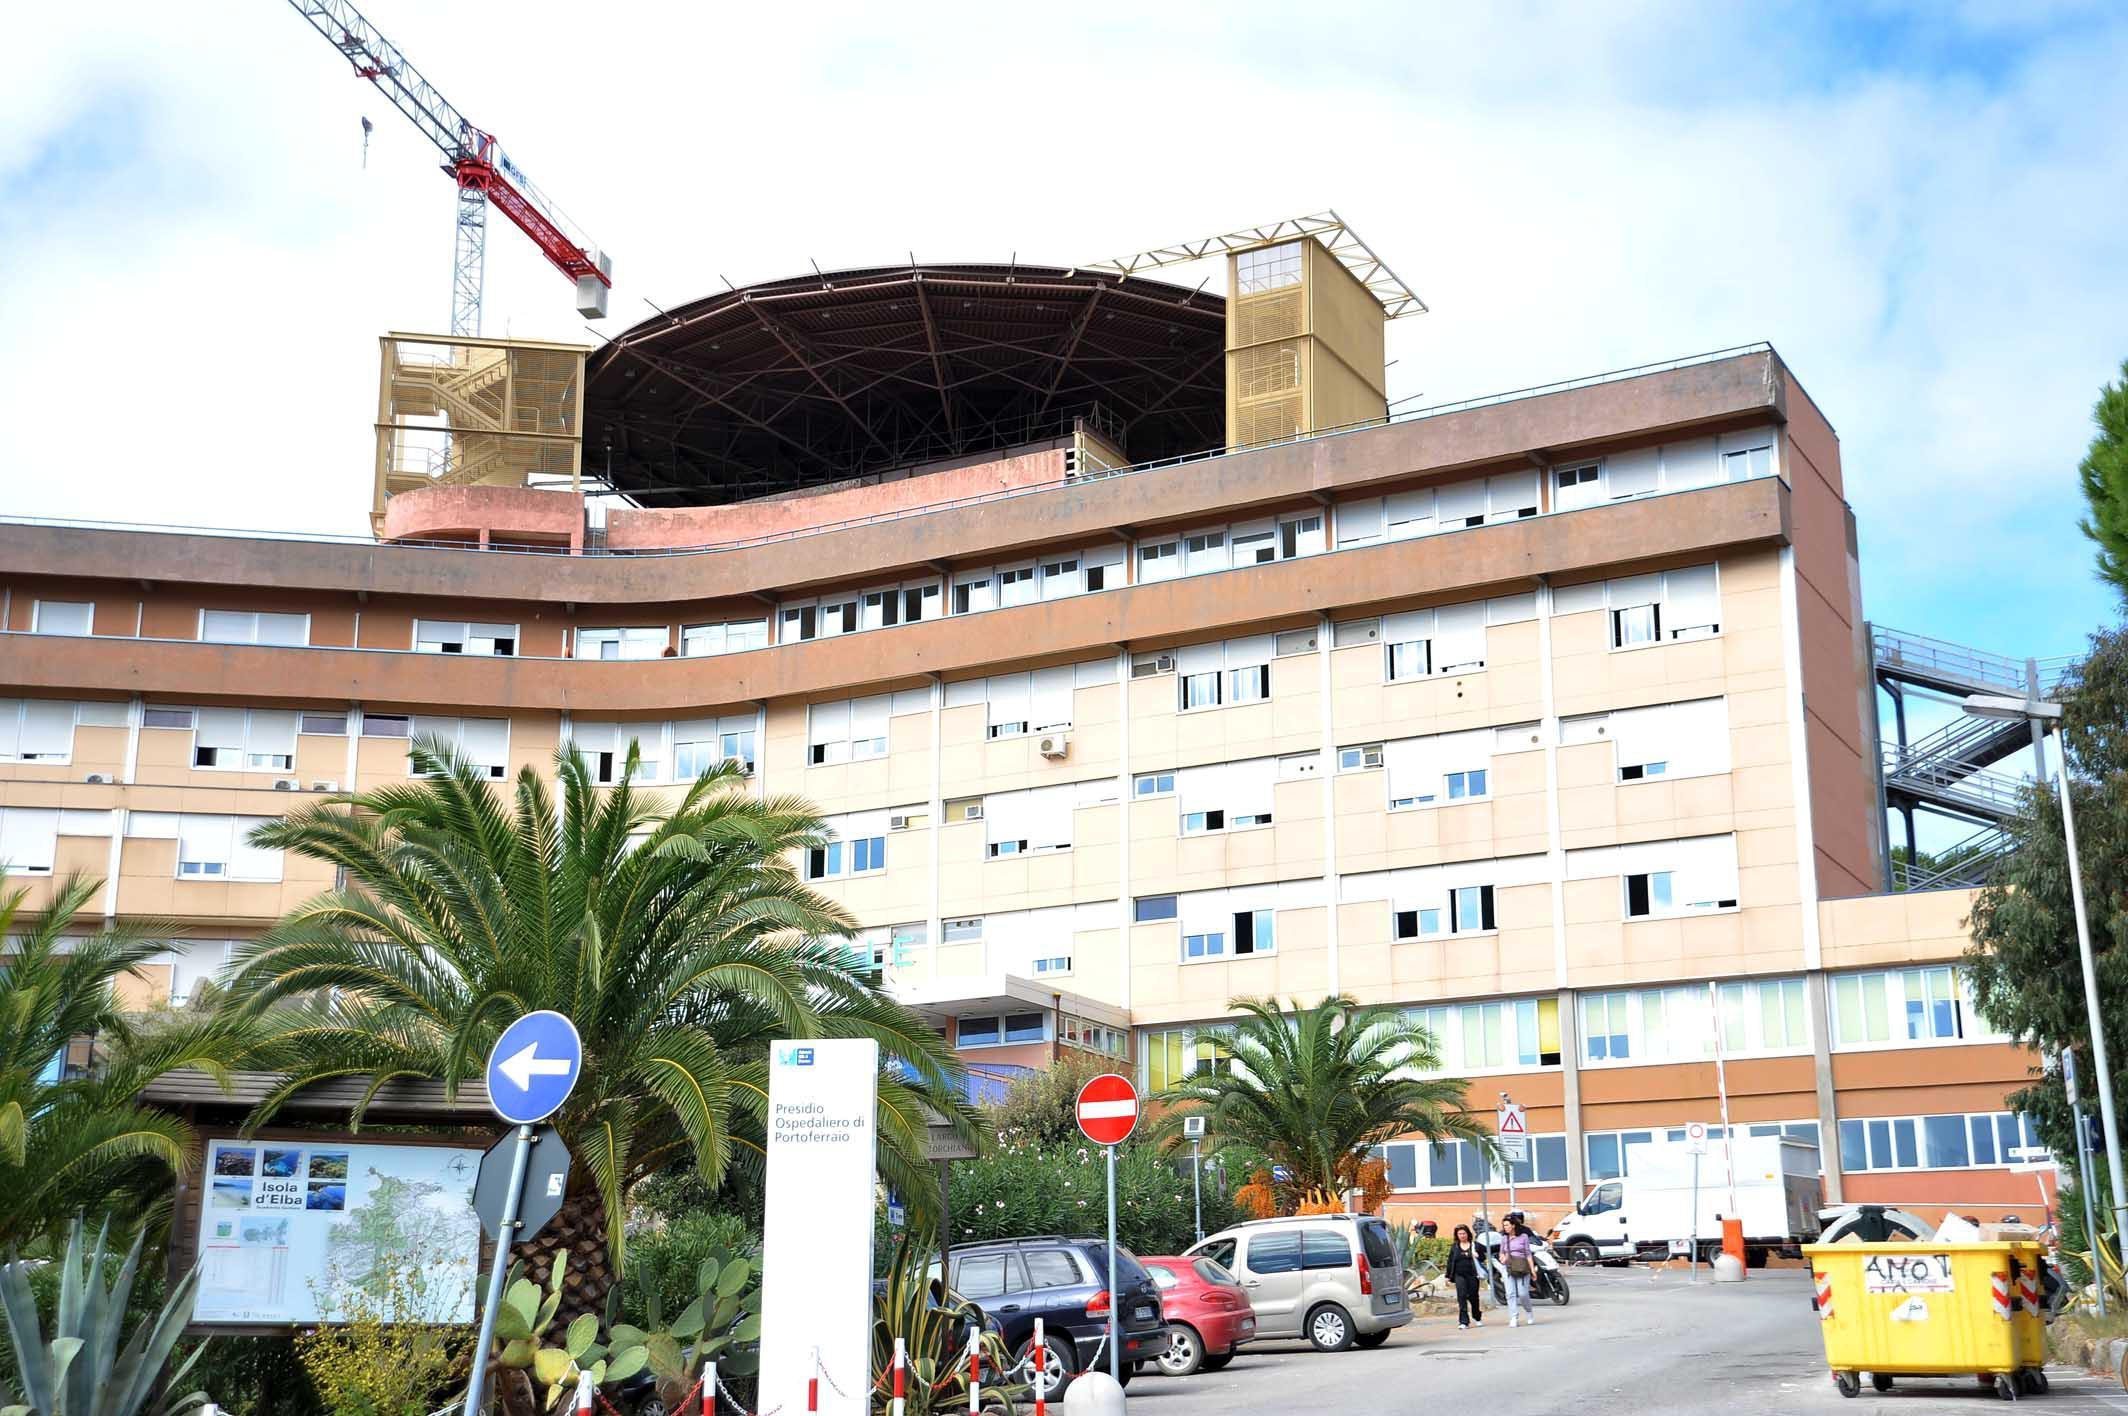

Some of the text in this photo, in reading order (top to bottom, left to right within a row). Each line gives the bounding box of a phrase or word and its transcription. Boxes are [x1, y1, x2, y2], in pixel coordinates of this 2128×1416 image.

[775, 1103, 824, 1115] Presidio
[775, 1115, 865, 1131] Ospedaliero di
[775, 1131, 850, 1143] Portoferraio
[263, 1181, 298, 1192] Isola
[255, 1194, 303, 1205] d'Elba
